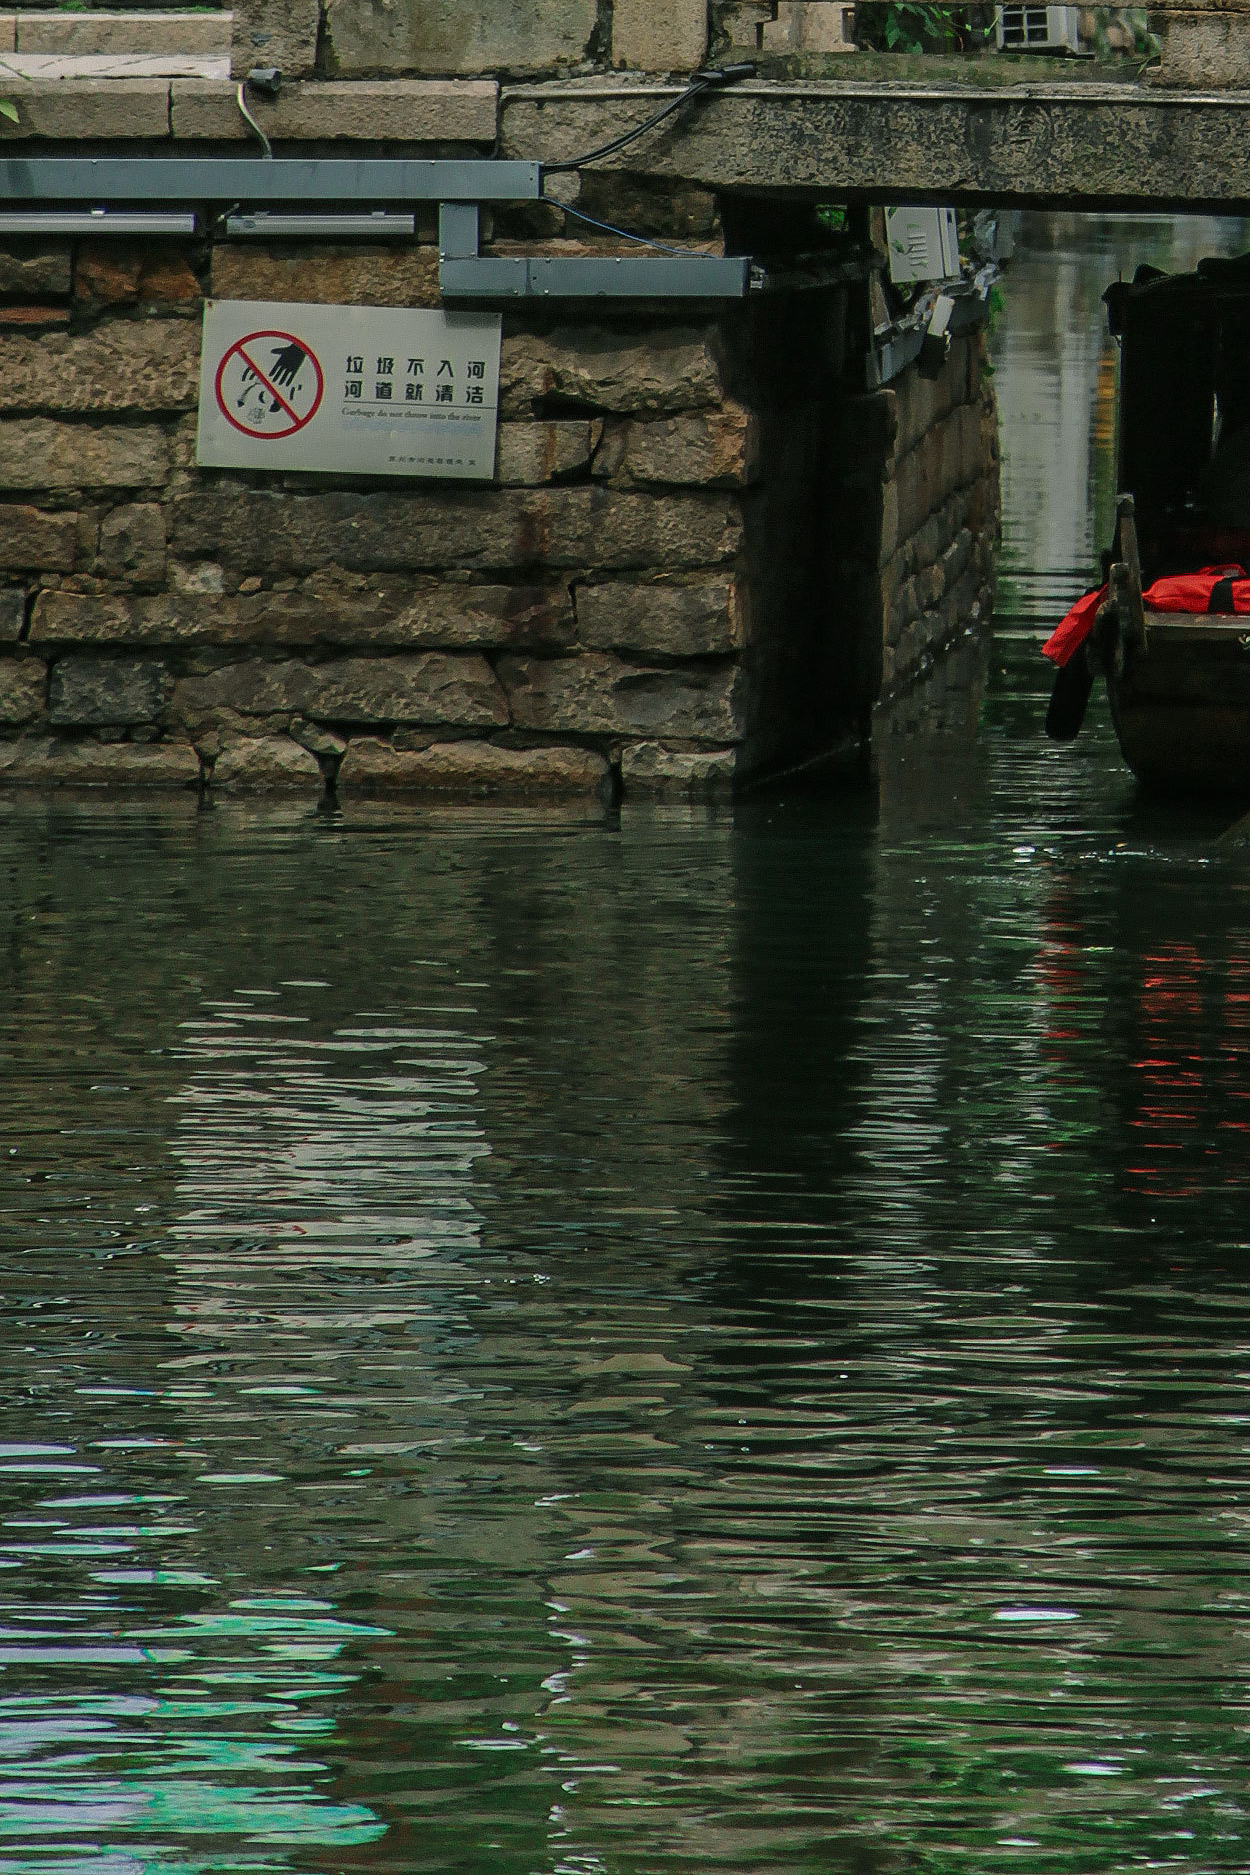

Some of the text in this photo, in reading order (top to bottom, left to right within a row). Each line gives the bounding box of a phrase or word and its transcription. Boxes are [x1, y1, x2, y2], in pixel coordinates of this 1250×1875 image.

[345, 356, 485, 380] 垃圾不入河
[344, 380, 484, 404] 河道就清洁
[342, 407, 375, 418] Garbage
[462, 414, 481, 422] river
